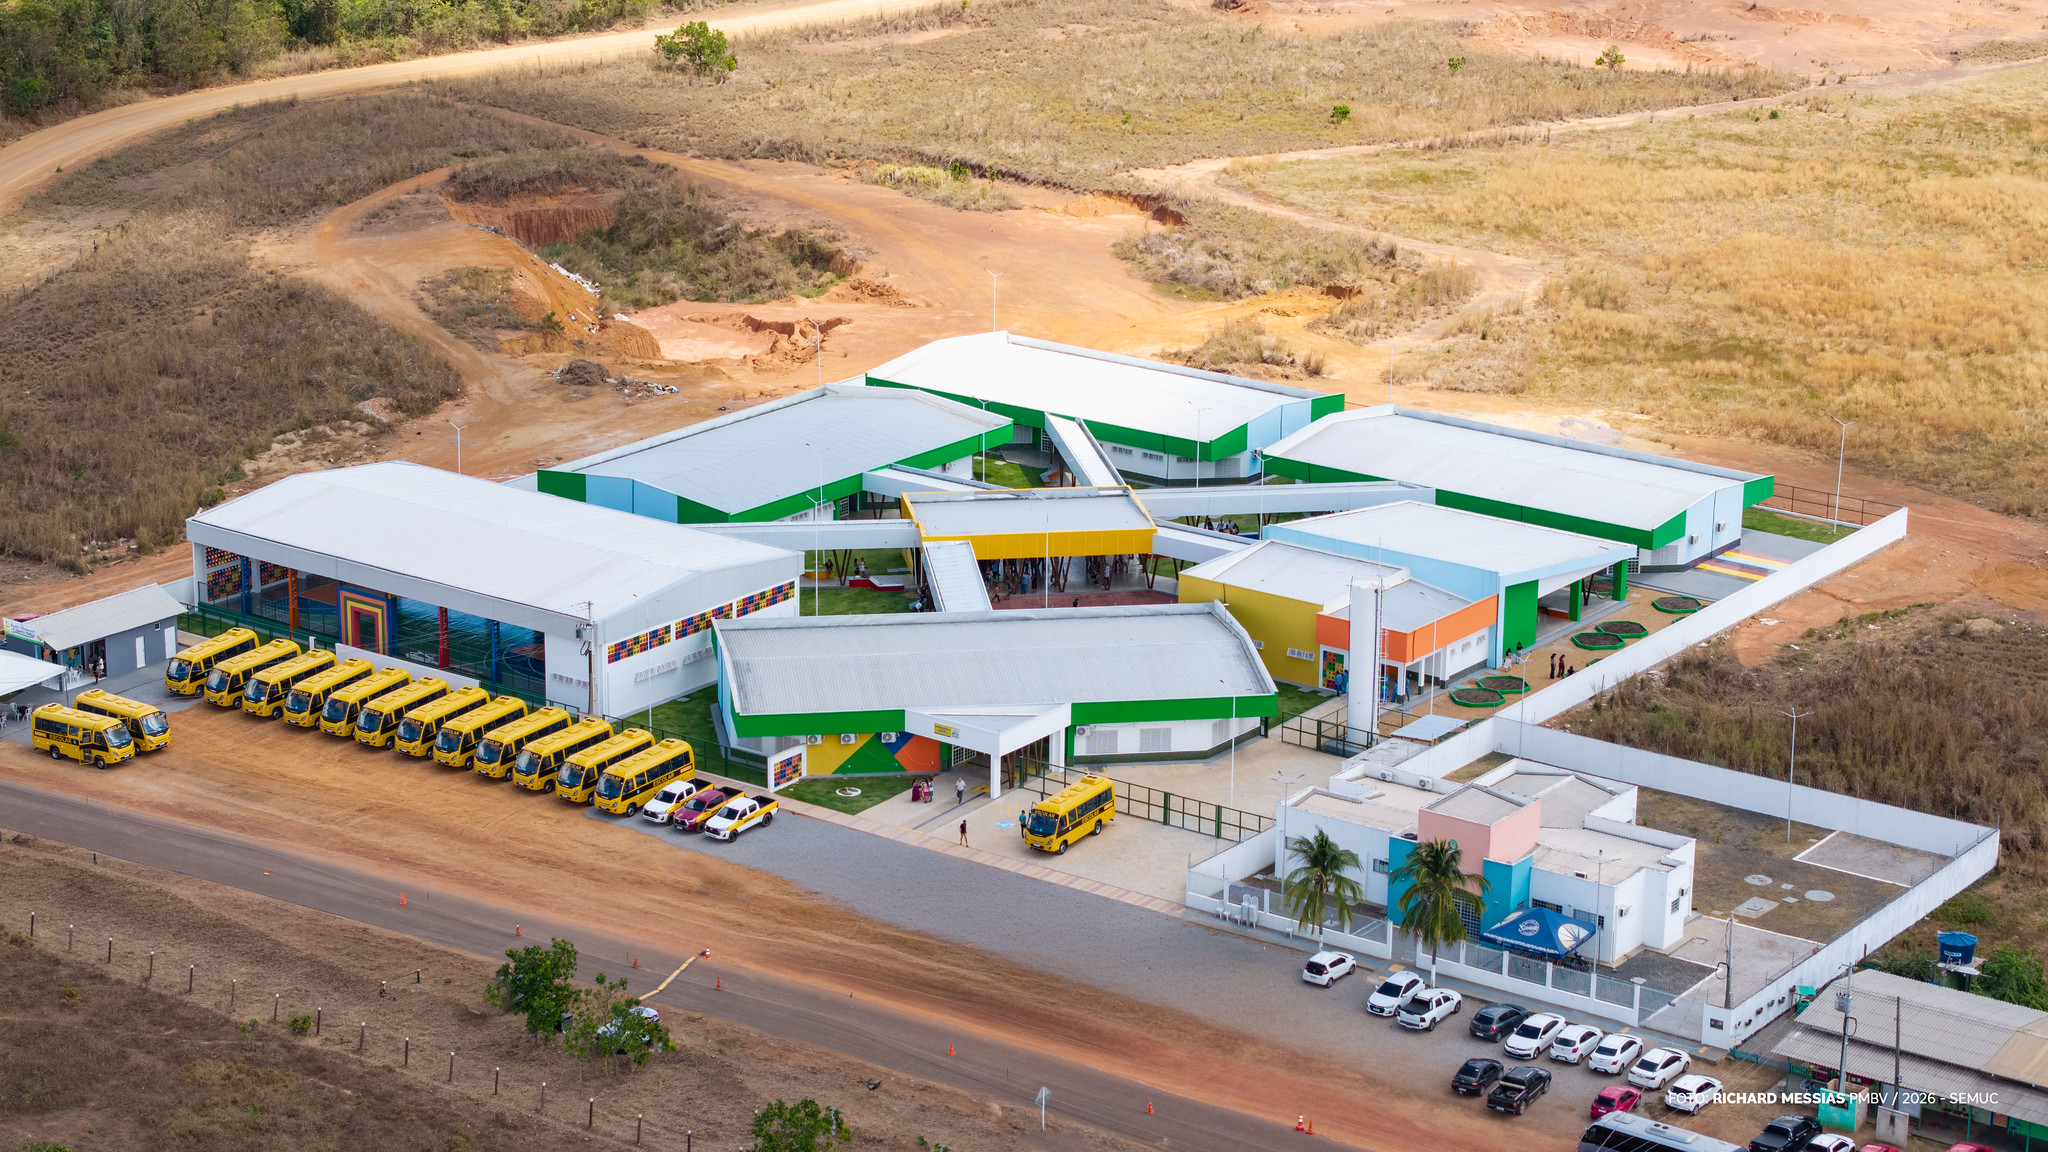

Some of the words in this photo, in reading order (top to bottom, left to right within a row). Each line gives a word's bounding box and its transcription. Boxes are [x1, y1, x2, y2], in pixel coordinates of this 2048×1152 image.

[442, 727, 459, 735] ESCOLAR
[50, 734, 72, 744] ESCOLAR
[653, 773, 674, 787] ESCOLAR
[1035, 810, 1056, 818] ESCOLAR
[1082, 810, 1099, 824] ESCOLAR
